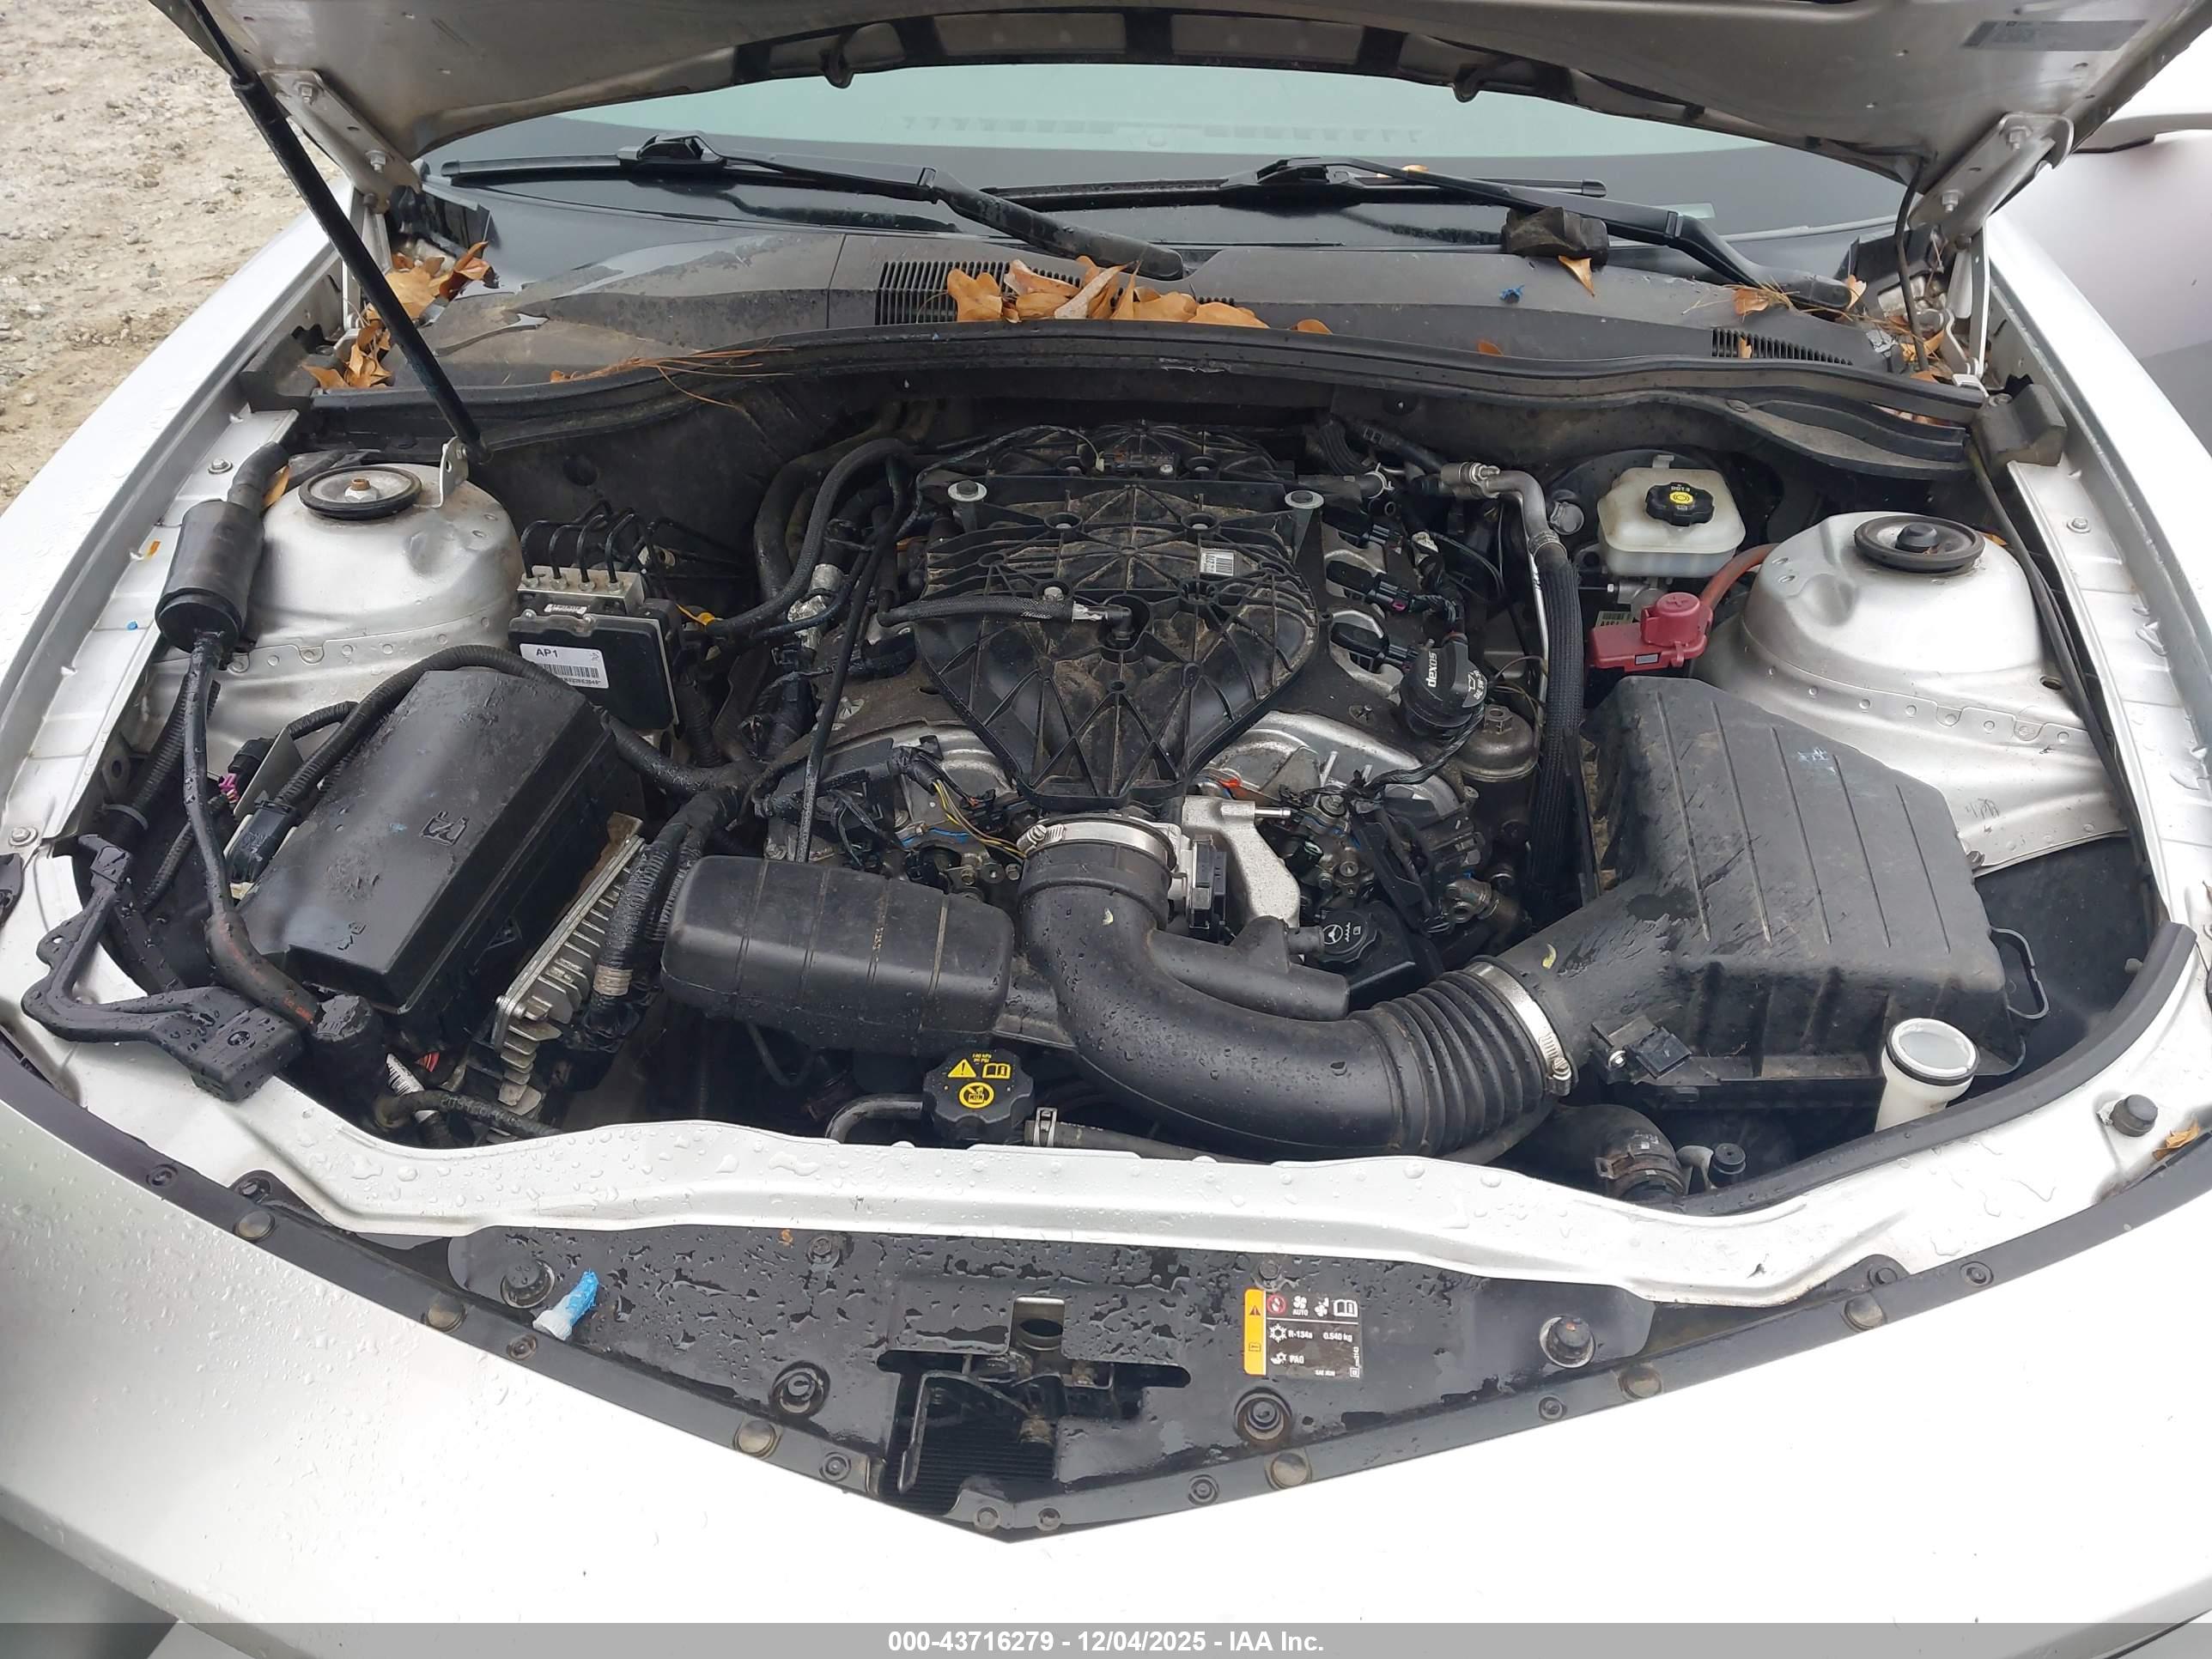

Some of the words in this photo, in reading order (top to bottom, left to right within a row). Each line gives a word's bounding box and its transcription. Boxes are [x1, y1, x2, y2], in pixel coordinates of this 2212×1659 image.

[536, 647, 558, 659] AP1
[1426, 651, 1437, 688] dexos
[1473, 689, 1484, 700] SAE
[1288, 1330, 1313, 1340] R-134a
[1322, 1332, 1343, 1341] 0.540
[1343, 1334, 1352, 1343] kg
